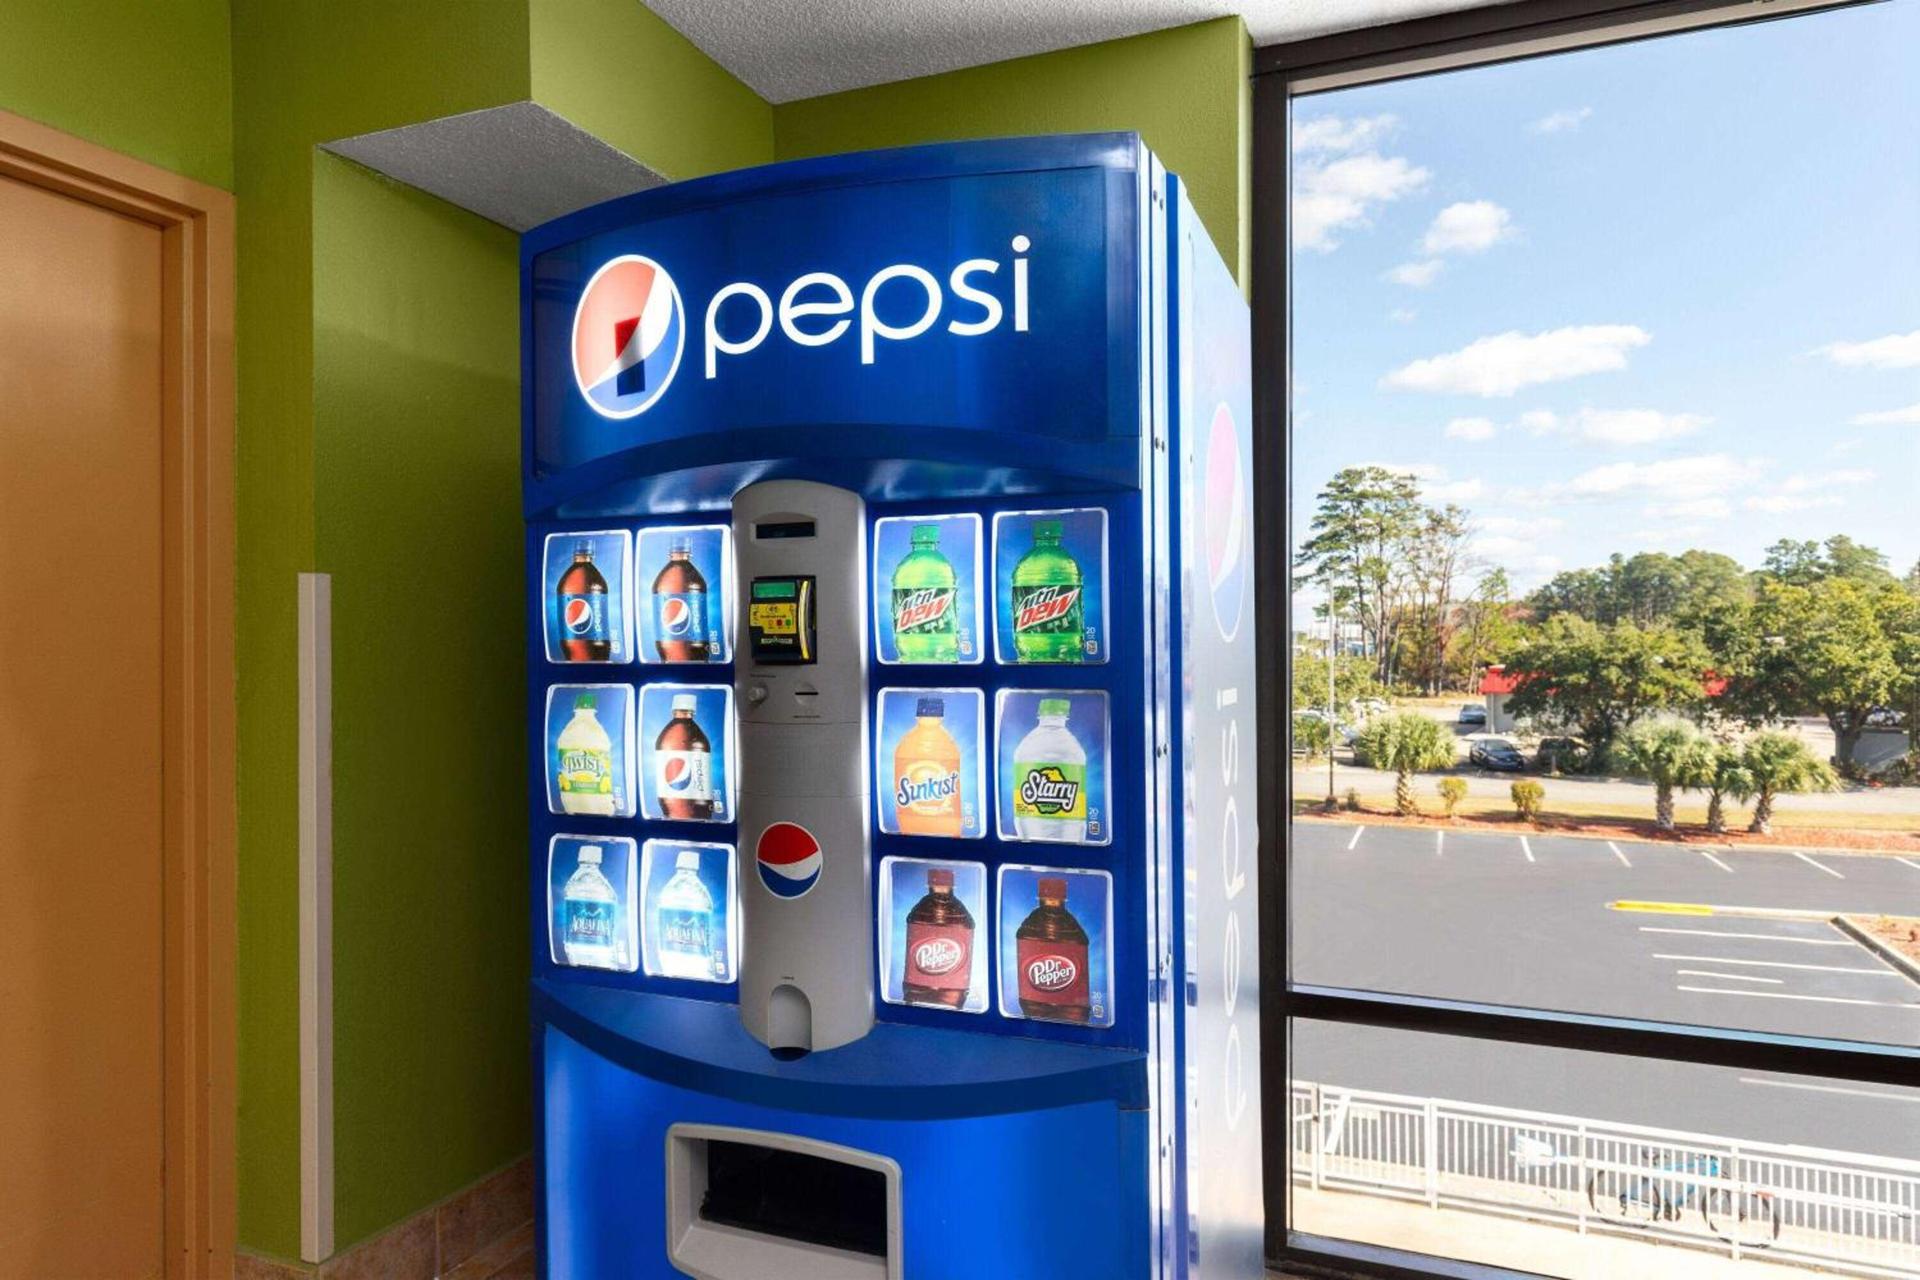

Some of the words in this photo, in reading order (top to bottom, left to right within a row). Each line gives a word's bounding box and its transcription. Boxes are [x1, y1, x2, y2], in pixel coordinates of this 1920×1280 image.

[704, 234, 1032, 380] pepsi
[897, 772, 960, 806] Sunkist
[1022, 769, 1078, 811] Starry
[917, 945, 958, 968] Pepper
[932, 943, 948, 954] Dr
[1031, 962, 1073, 985] Pepper
[1045, 960, 1062, 973] Dr
